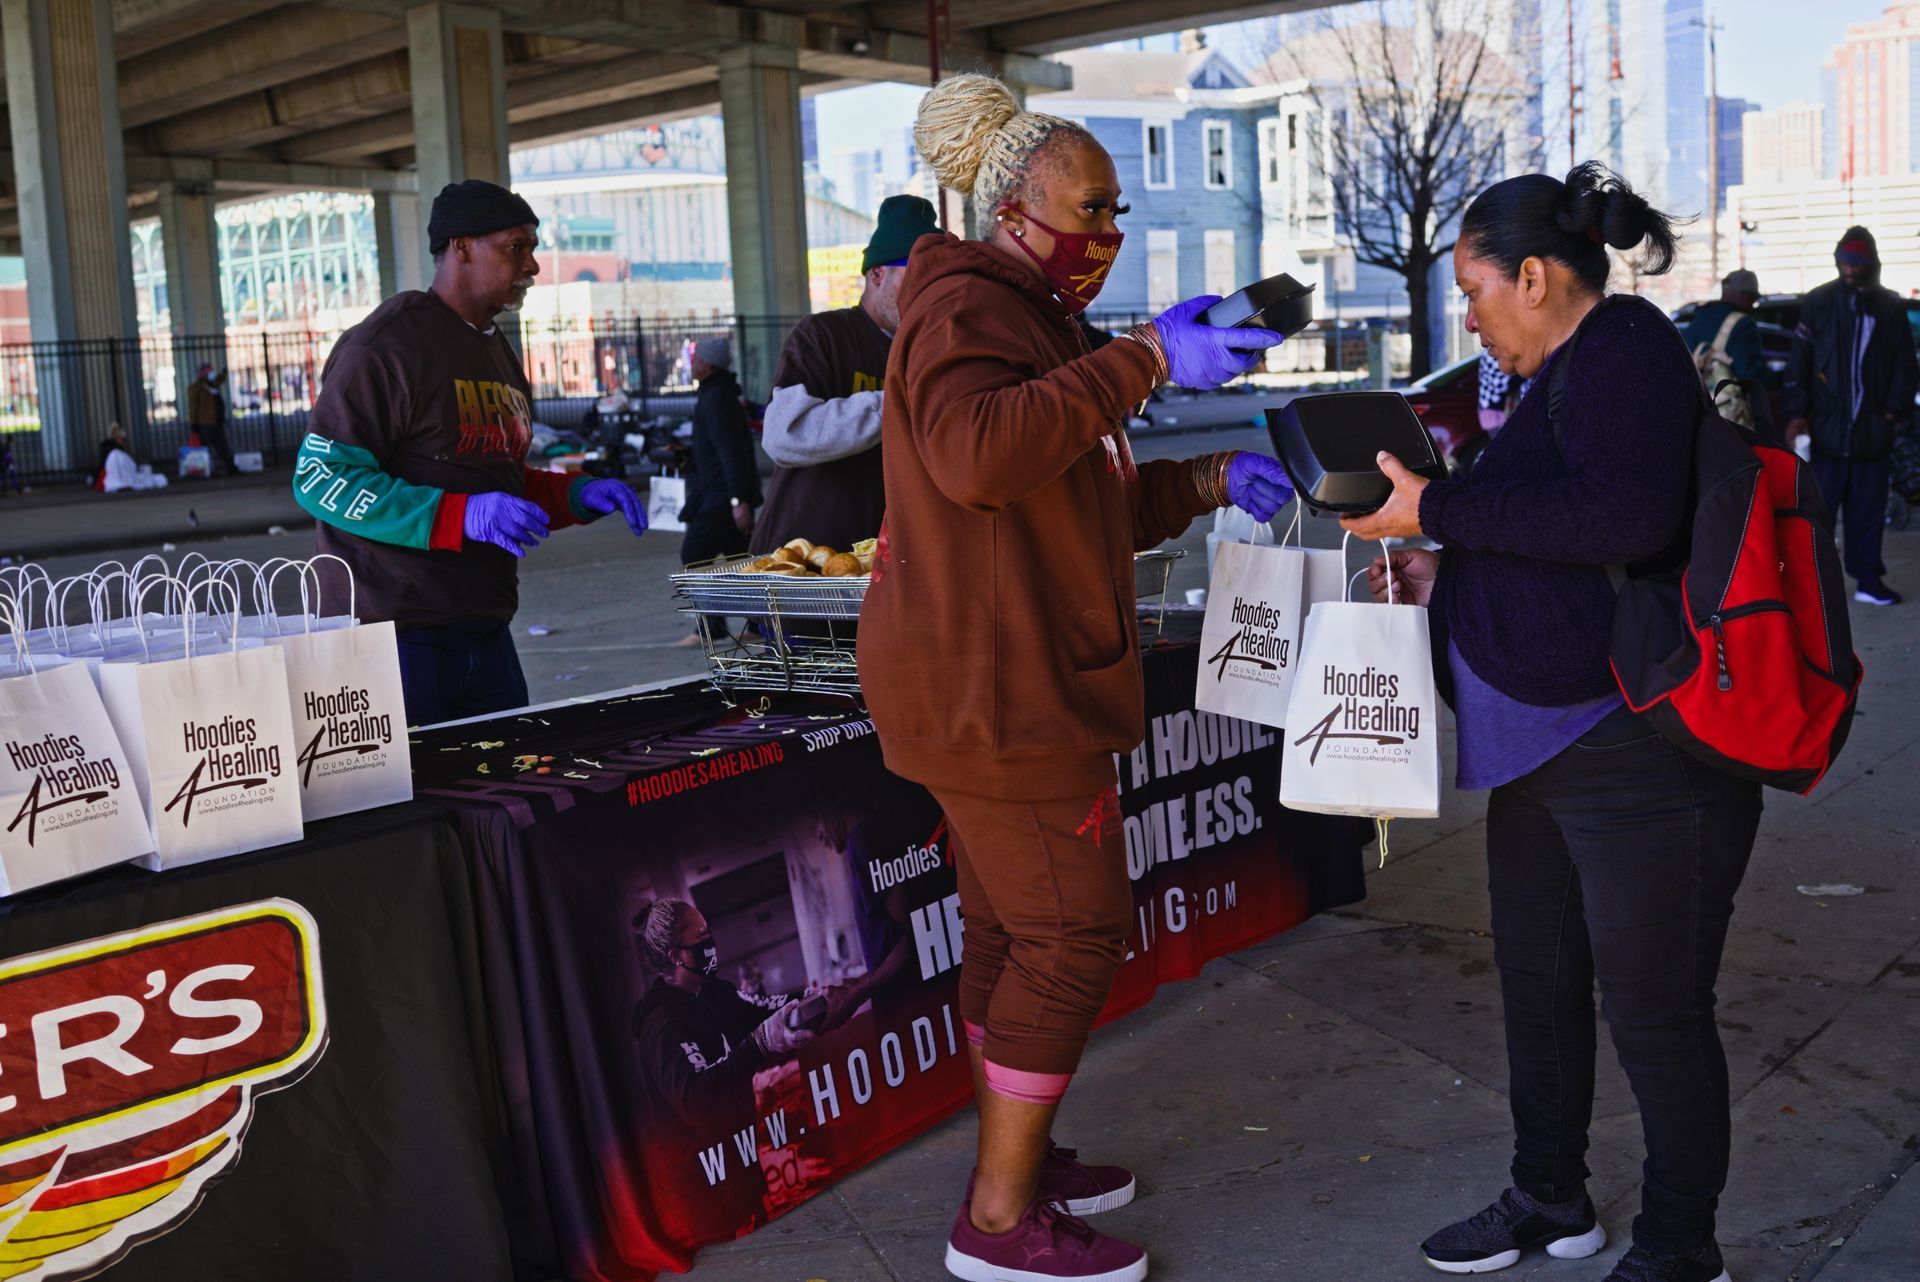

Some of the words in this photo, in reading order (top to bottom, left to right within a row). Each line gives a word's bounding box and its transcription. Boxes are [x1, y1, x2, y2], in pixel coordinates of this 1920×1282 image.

[1231, 597, 1280, 630] Hoodies
[1240, 625, 1290, 668] Healing
[1228, 664, 1282, 681] FOUNDATION
[1323, 665, 1399, 698] Hoodies
[304, 686, 370, 720] Hoodies
[1344, 697, 1420, 740] Healing
[183, 715, 257, 753] Hoodies
[327, 711, 392, 747] Healing
[801, 726, 841, 753] SHOP
[5, 733, 85, 771] Hoodies
[208, 742, 281, 782] Healing
[316, 753, 387, 771] FOUNDATION
[1326, 744, 1412, 756] FOUNDATION
[1326, 753, 1409, 764] www.hoodies4healing.org
[40, 757, 120, 798] Healing
[627, 741, 784, 807] #HOODIES4HEALING
[41, 800, 118, 825] FOUNDATION
[197, 787, 276, 813] FOUNDATION
[198, 795, 274, 815] www.hoodies4healing.org
[868, 843, 941, 894] Hoodies
